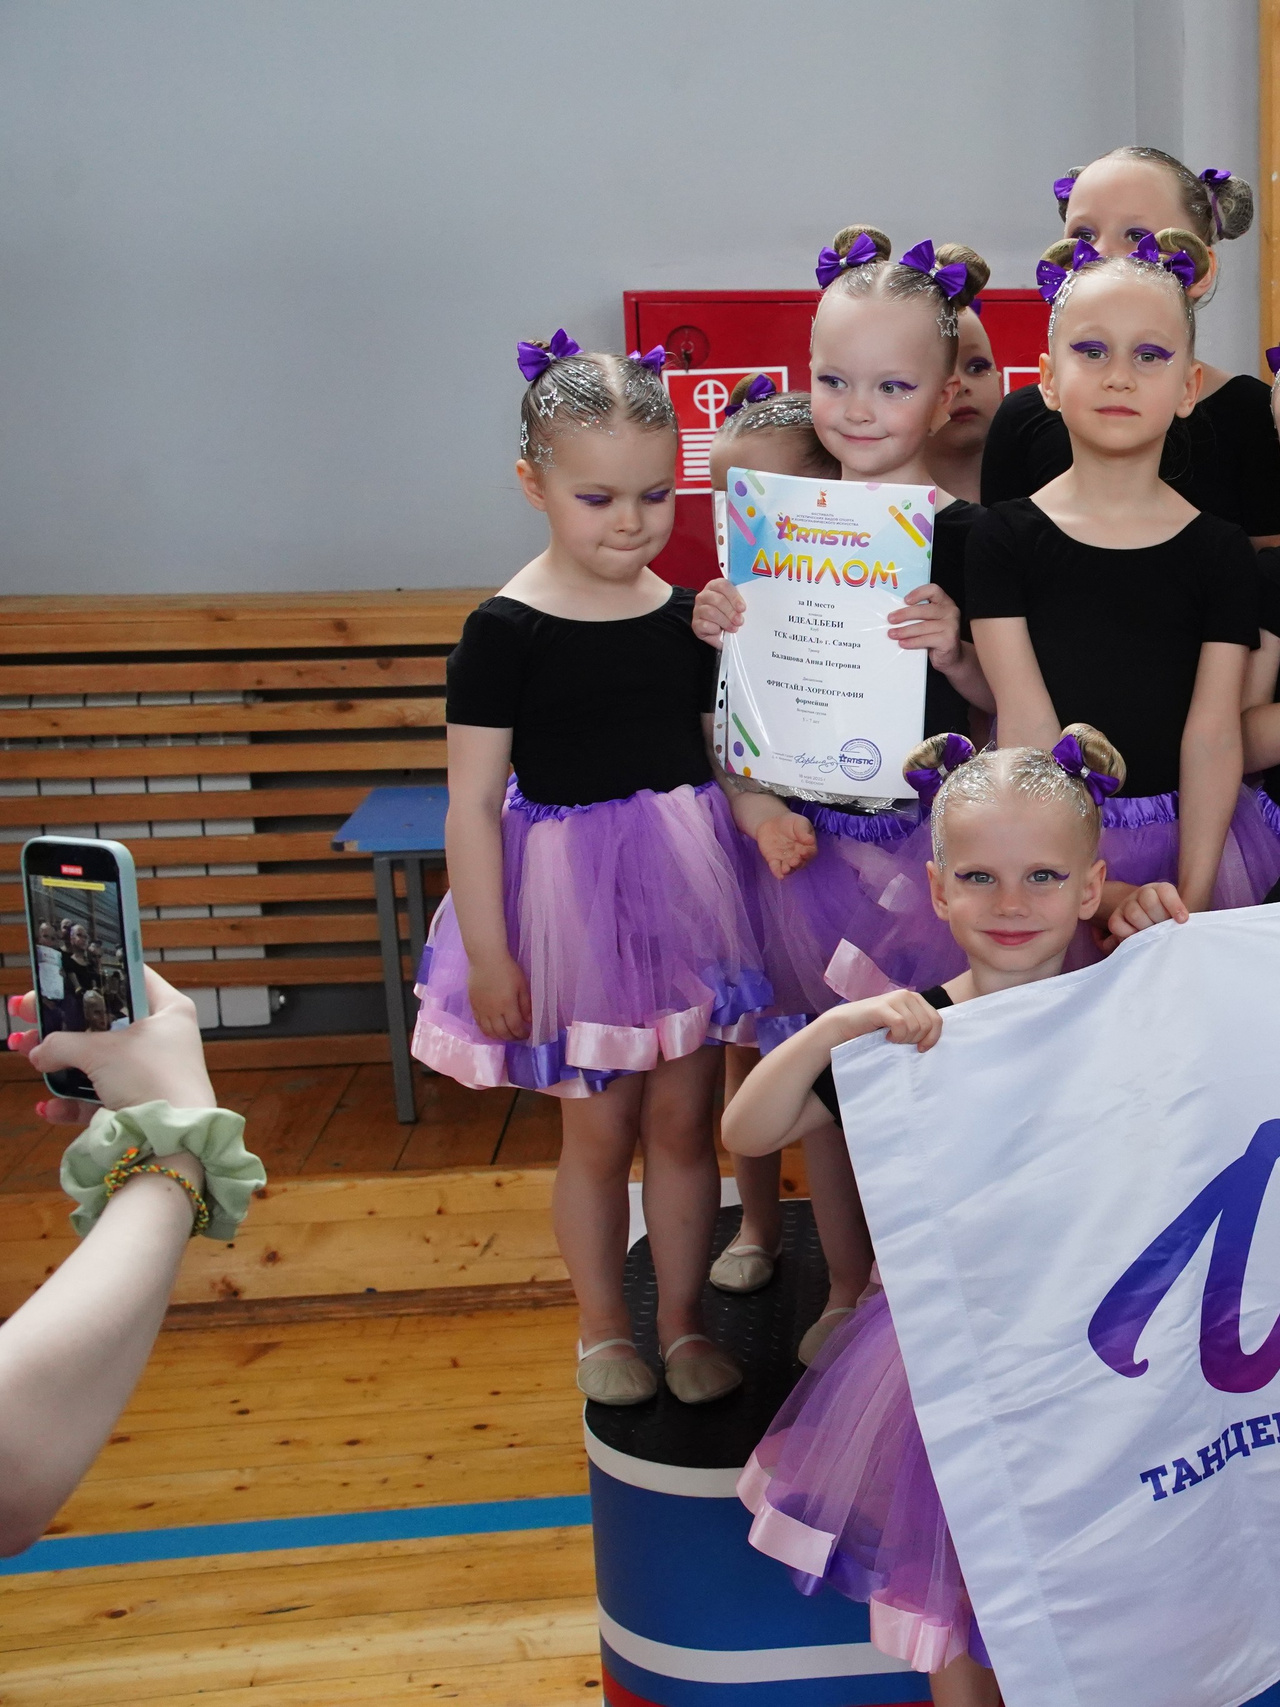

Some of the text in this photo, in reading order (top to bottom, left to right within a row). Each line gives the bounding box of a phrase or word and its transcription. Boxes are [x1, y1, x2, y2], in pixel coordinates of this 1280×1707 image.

[776, 514, 871, 548] ARTISTIC
[751, 548, 899, 589] ДИПЛОМ
[774, 630, 788, 639] ТСК
[789, 634, 823, 645] «ИДЕАЛ»
[832, 639, 861, 649] Самара
[771, 651, 861, 669] Балашова Анна Петровна
[766, 679, 803, 691] ФРИСТАЙЛ
